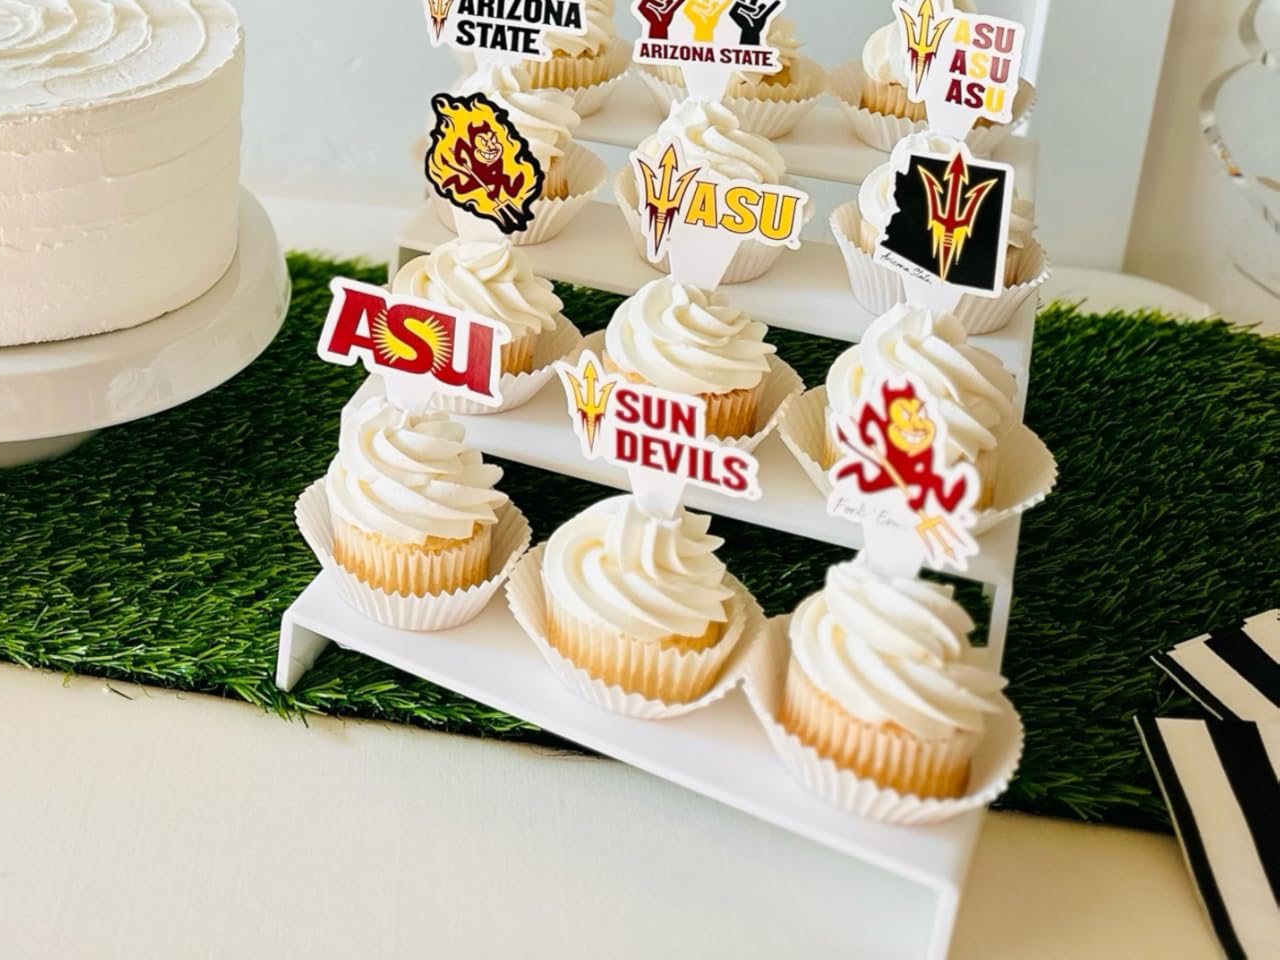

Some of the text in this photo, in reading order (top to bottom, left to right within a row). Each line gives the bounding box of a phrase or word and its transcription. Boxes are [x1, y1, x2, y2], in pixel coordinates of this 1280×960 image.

[456, 20, 541, 55] STATE
[952, 19, 1016, 53] ASU
[640, 43, 773, 67] ARIZONA STATE
[949, 49, 1011, 83] ASU
[945, 78, 1005, 113] ASU
[684, 181, 800, 240] ASU
[328, 287, 494, 398] ASU
[616, 389, 696, 438] SUN
[616, 428, 748, 491] DEVILS
